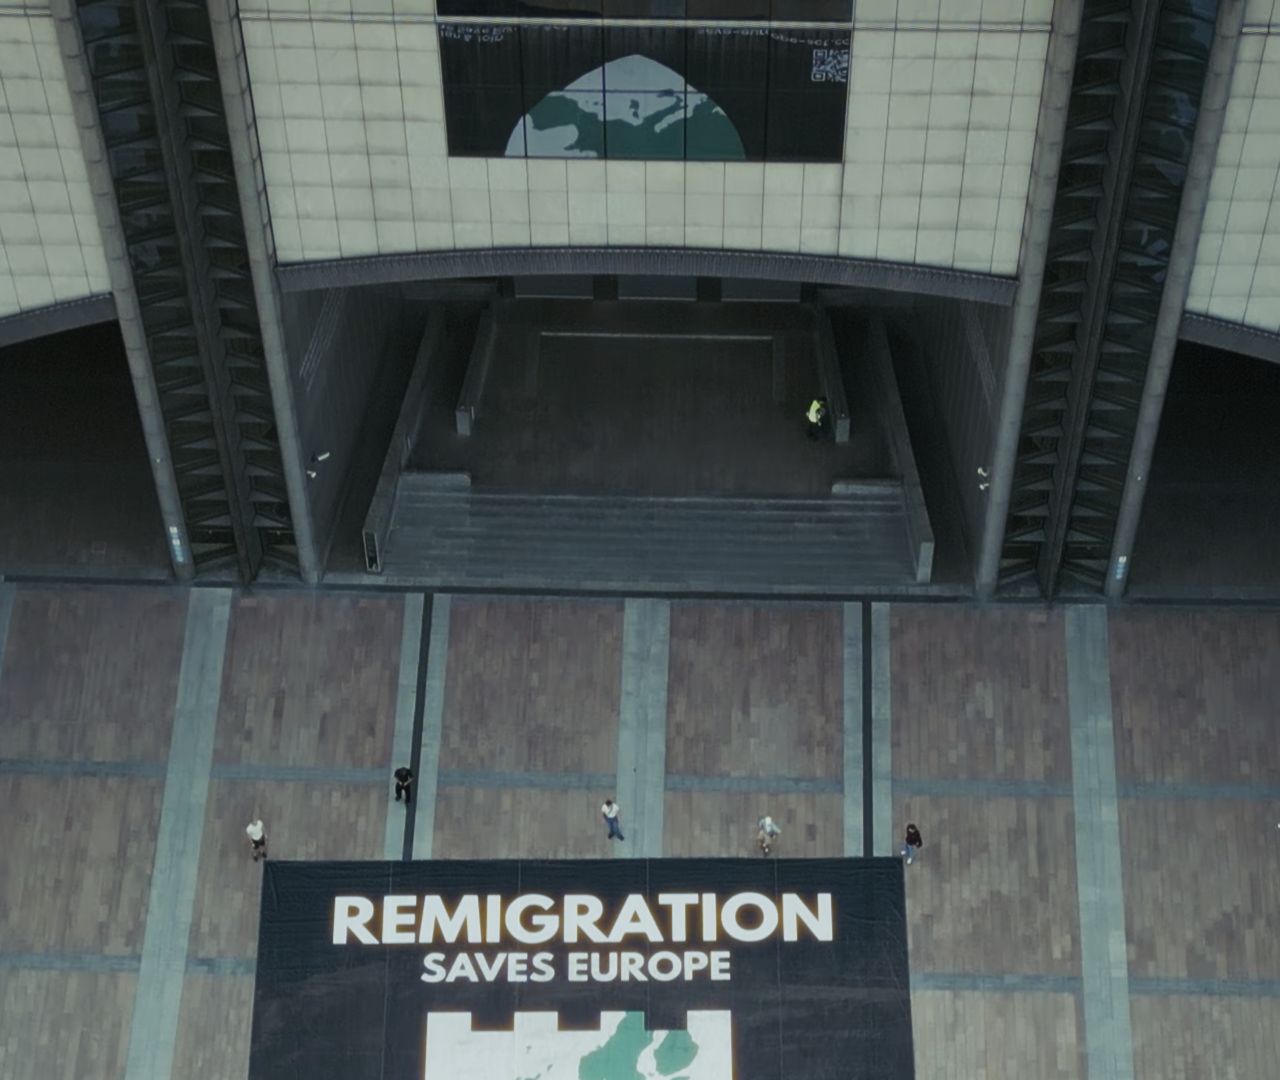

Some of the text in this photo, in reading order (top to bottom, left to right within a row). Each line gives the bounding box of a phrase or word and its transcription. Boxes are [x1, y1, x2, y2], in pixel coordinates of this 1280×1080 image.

[332, 892, 833, 945] REMIGRATION
[421, 951, 731, 983] SAVES EUROPE
